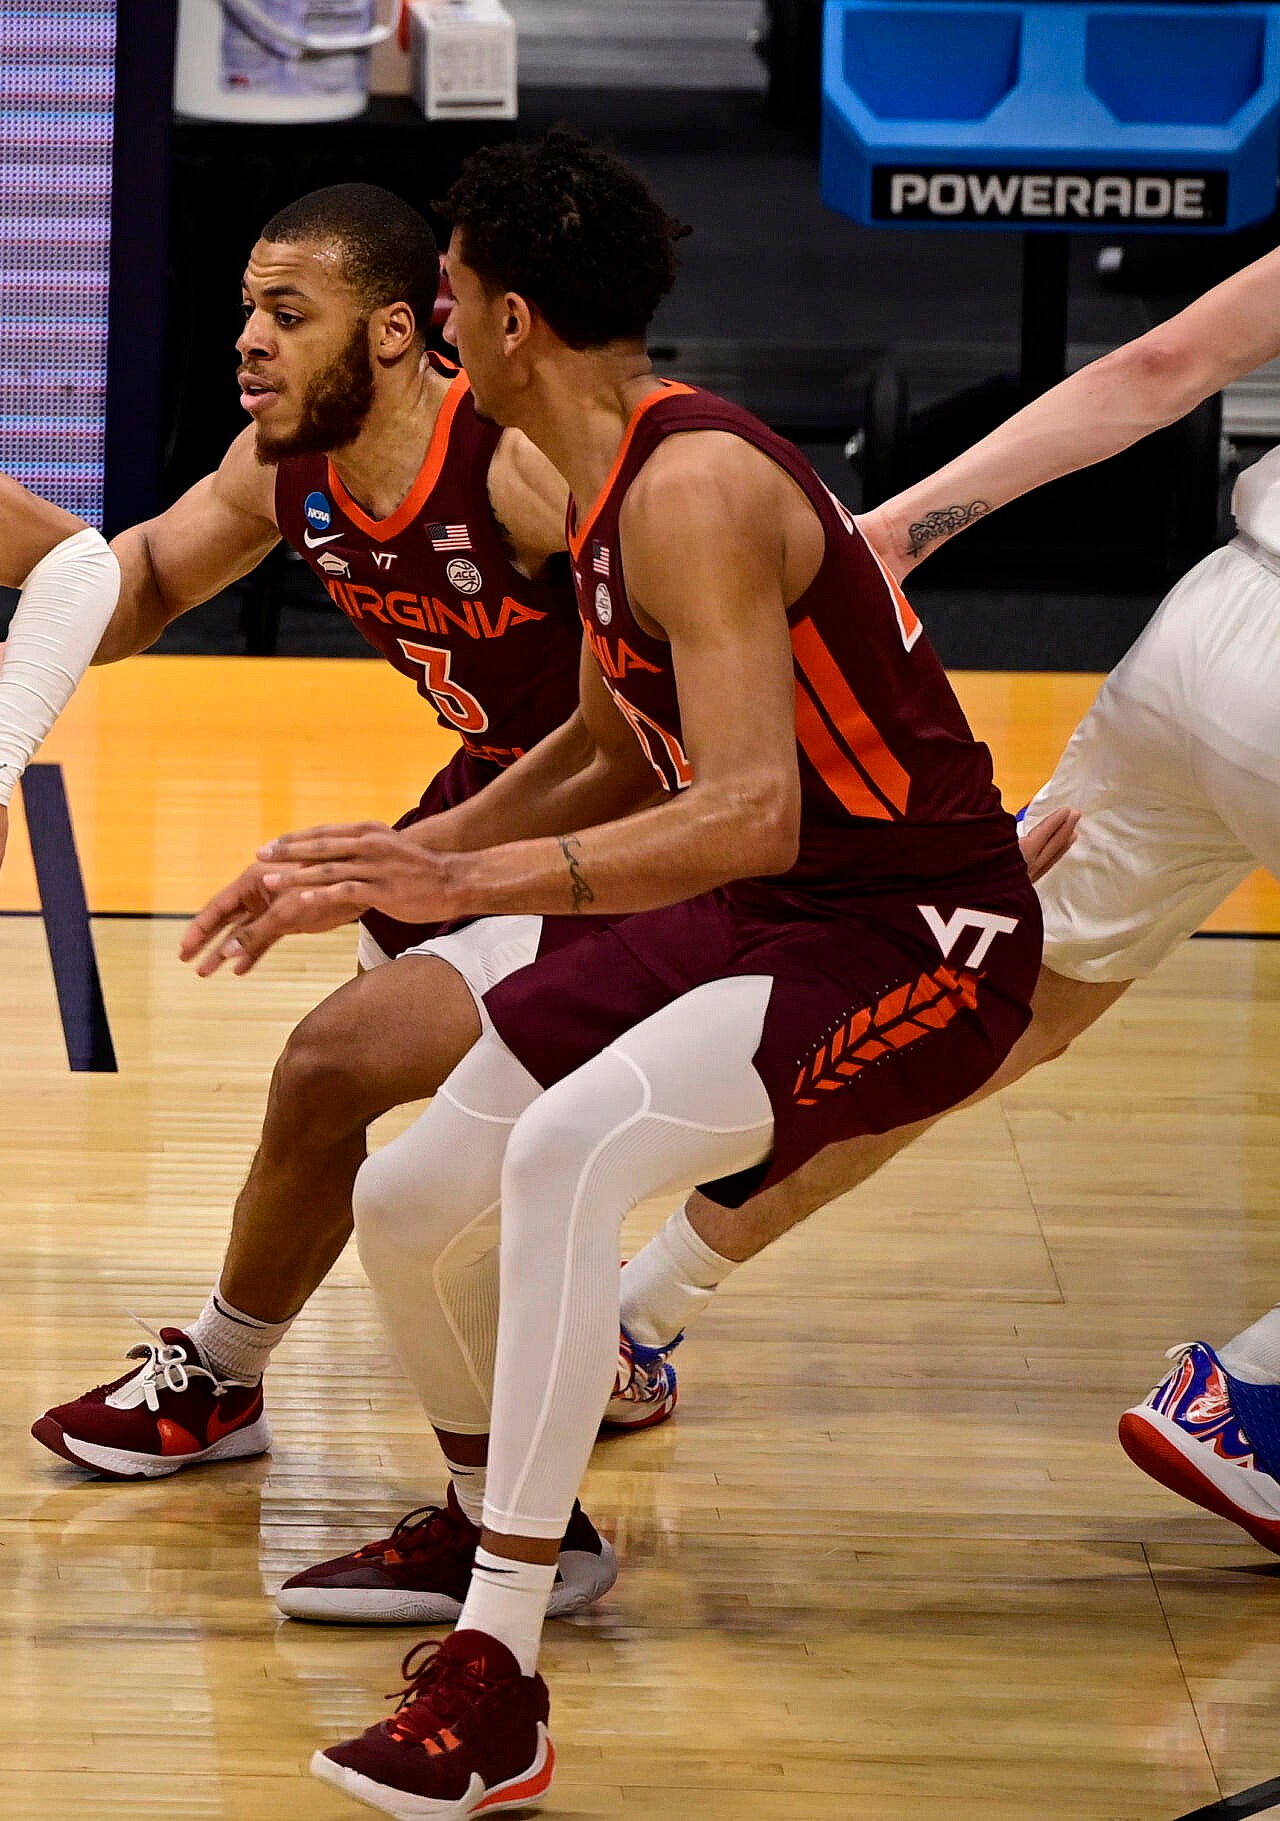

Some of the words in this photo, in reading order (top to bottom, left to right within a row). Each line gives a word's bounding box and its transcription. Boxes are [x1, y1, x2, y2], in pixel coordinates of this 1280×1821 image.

[889, 173, 1206, 219] POWERADE
[307, 507, 331, 524] NCAA
[371, 551, 398, 570] VT
[453, 570, 477, 581] ACC
[396, 638, 489, 734] 3
[916, 904, 1020, 969] VT
